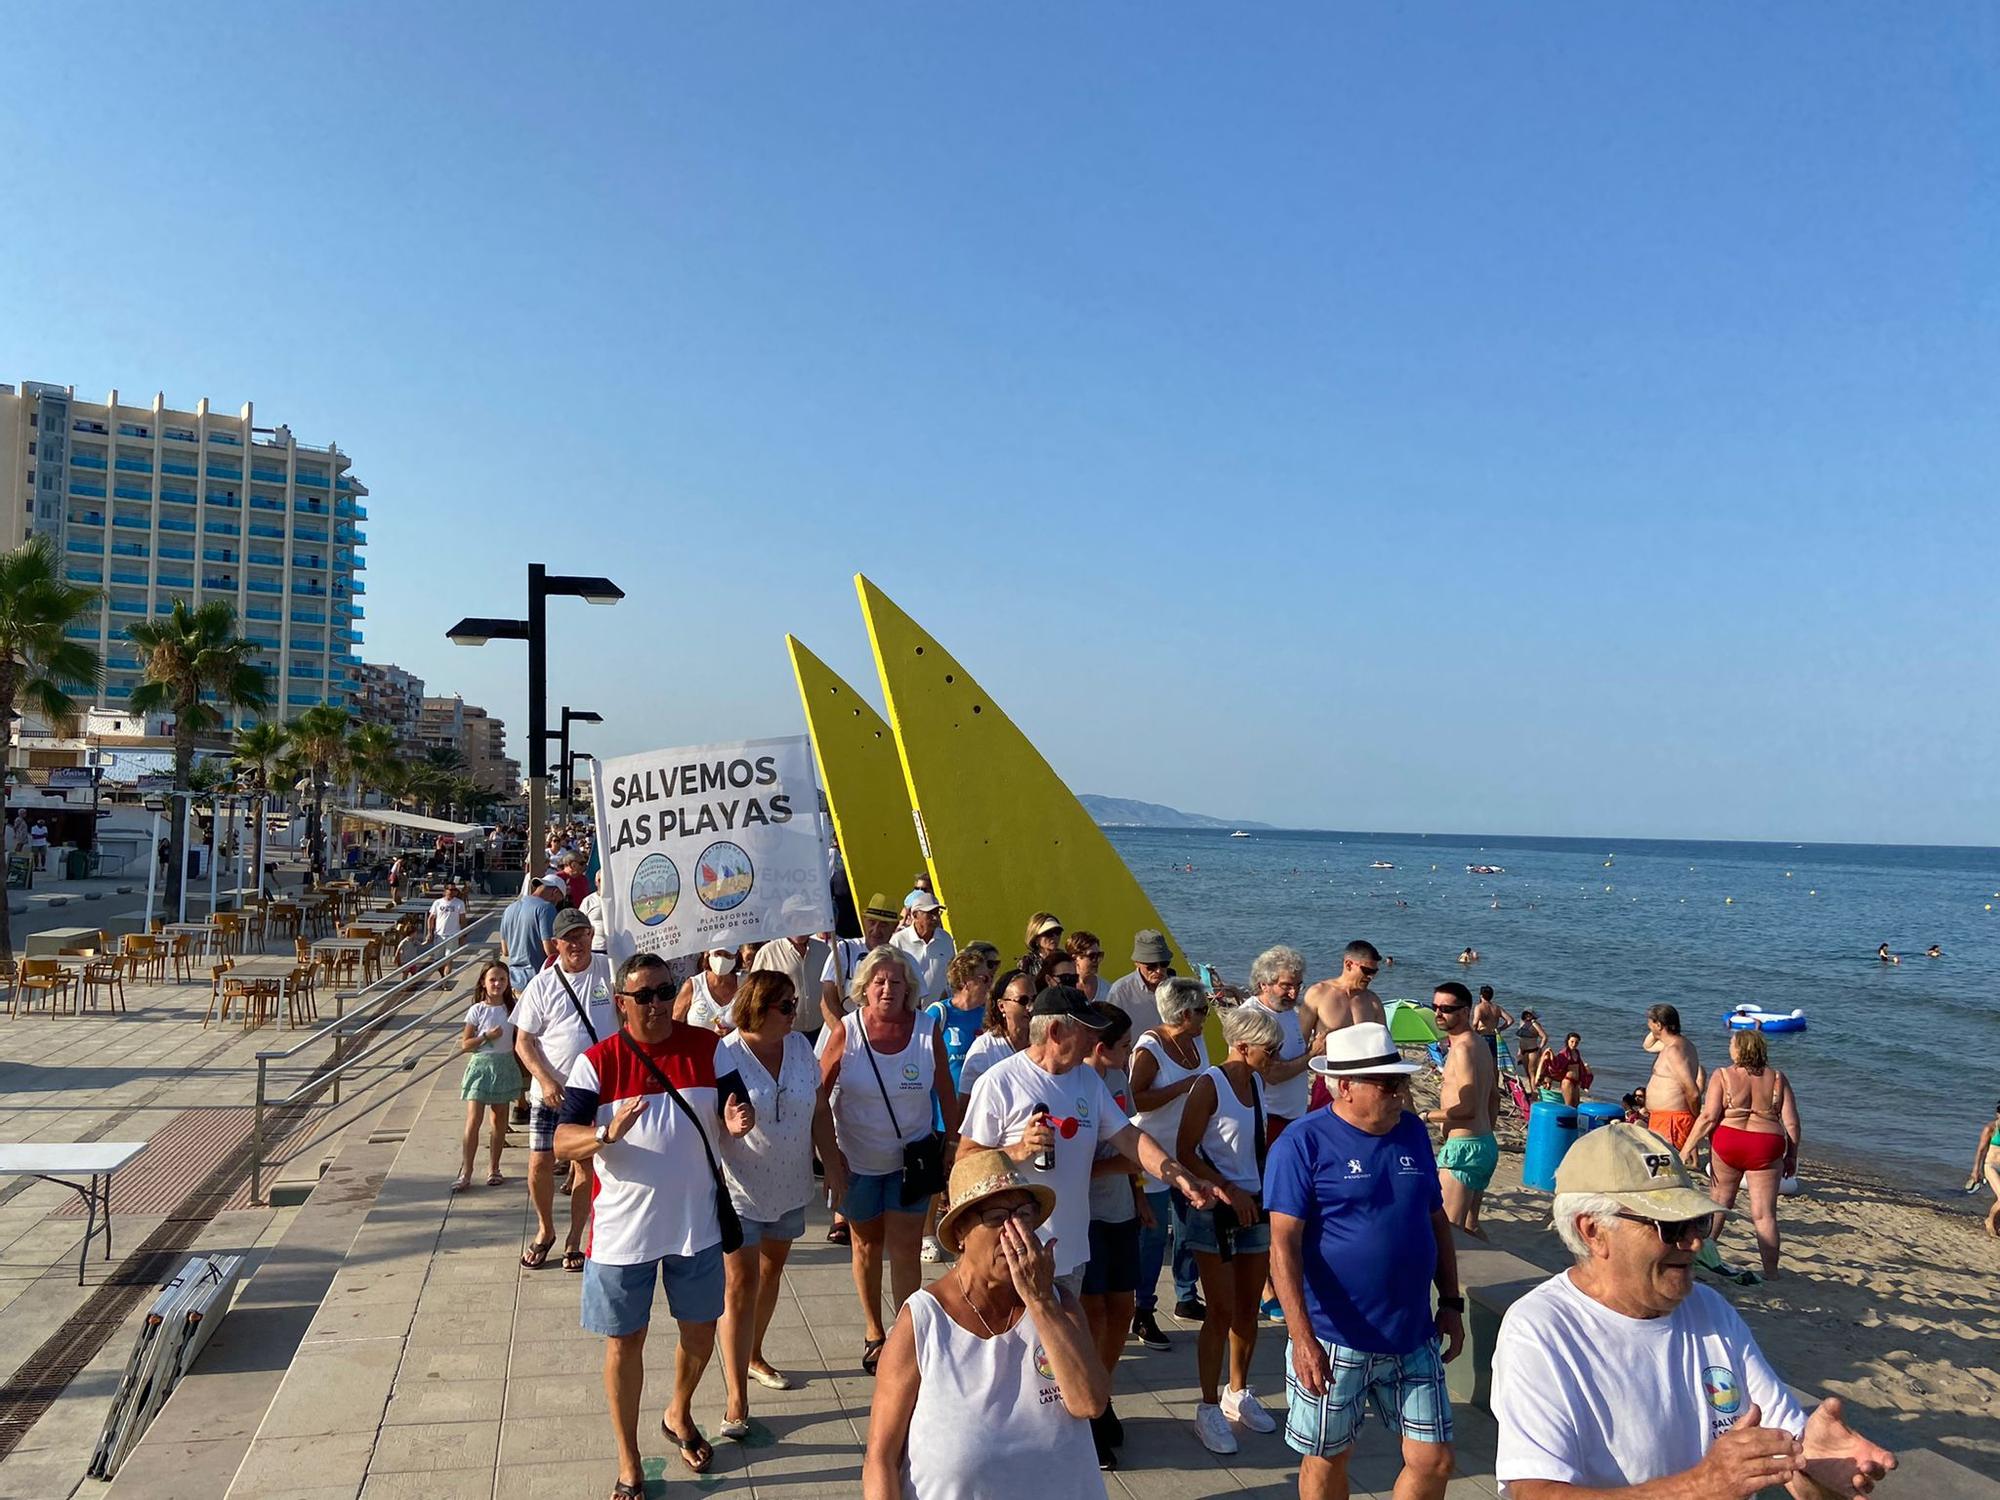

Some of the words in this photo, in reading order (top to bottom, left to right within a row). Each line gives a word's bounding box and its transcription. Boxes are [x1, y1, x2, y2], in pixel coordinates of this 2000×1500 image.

[610, 757, 777, 809] SALVEMOS
[608, 814, 651, 854] LAS
[659, 795, 792, 841] PLAYAS
[700, 911, 754, 924] PLATAFORMA
[1040, 1386, 1061, 1397] SALV
[1040, 1395, 1053, 1404] LAS
